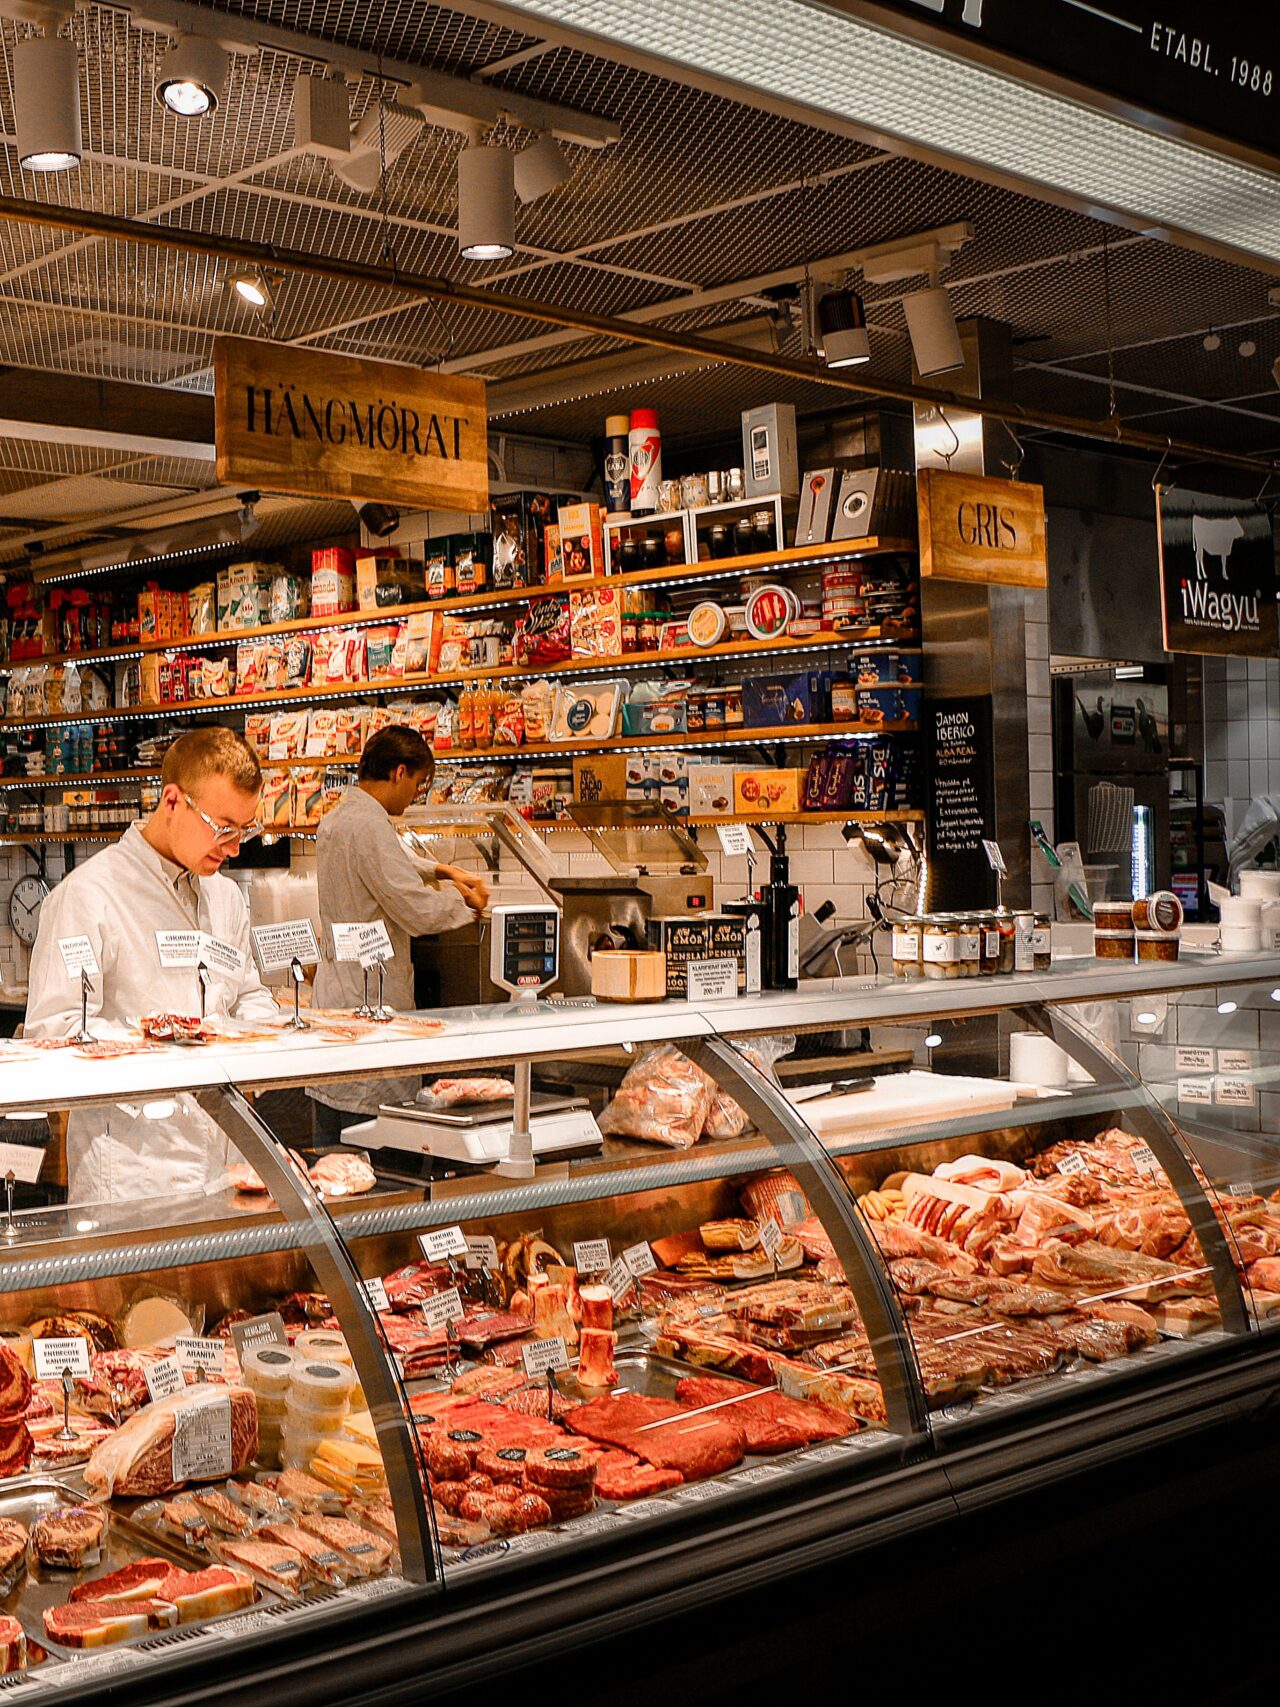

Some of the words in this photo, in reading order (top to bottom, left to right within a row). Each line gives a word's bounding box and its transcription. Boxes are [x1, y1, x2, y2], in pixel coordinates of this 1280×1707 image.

[1150, 22, 1219, 77] ETABL.
[1231, 56, 1273, 97] 1988
[246, 382, 469, 461] HÄNGMÖRAT
[957, 502, 1018, 550] GRIS
[1181, 579, 1260, 632] iWagyu
[935, 712, 969, 728] JAMON
[936, 724, 975, 741] IBERICO
[580, 780, 602, 792] CACAO
